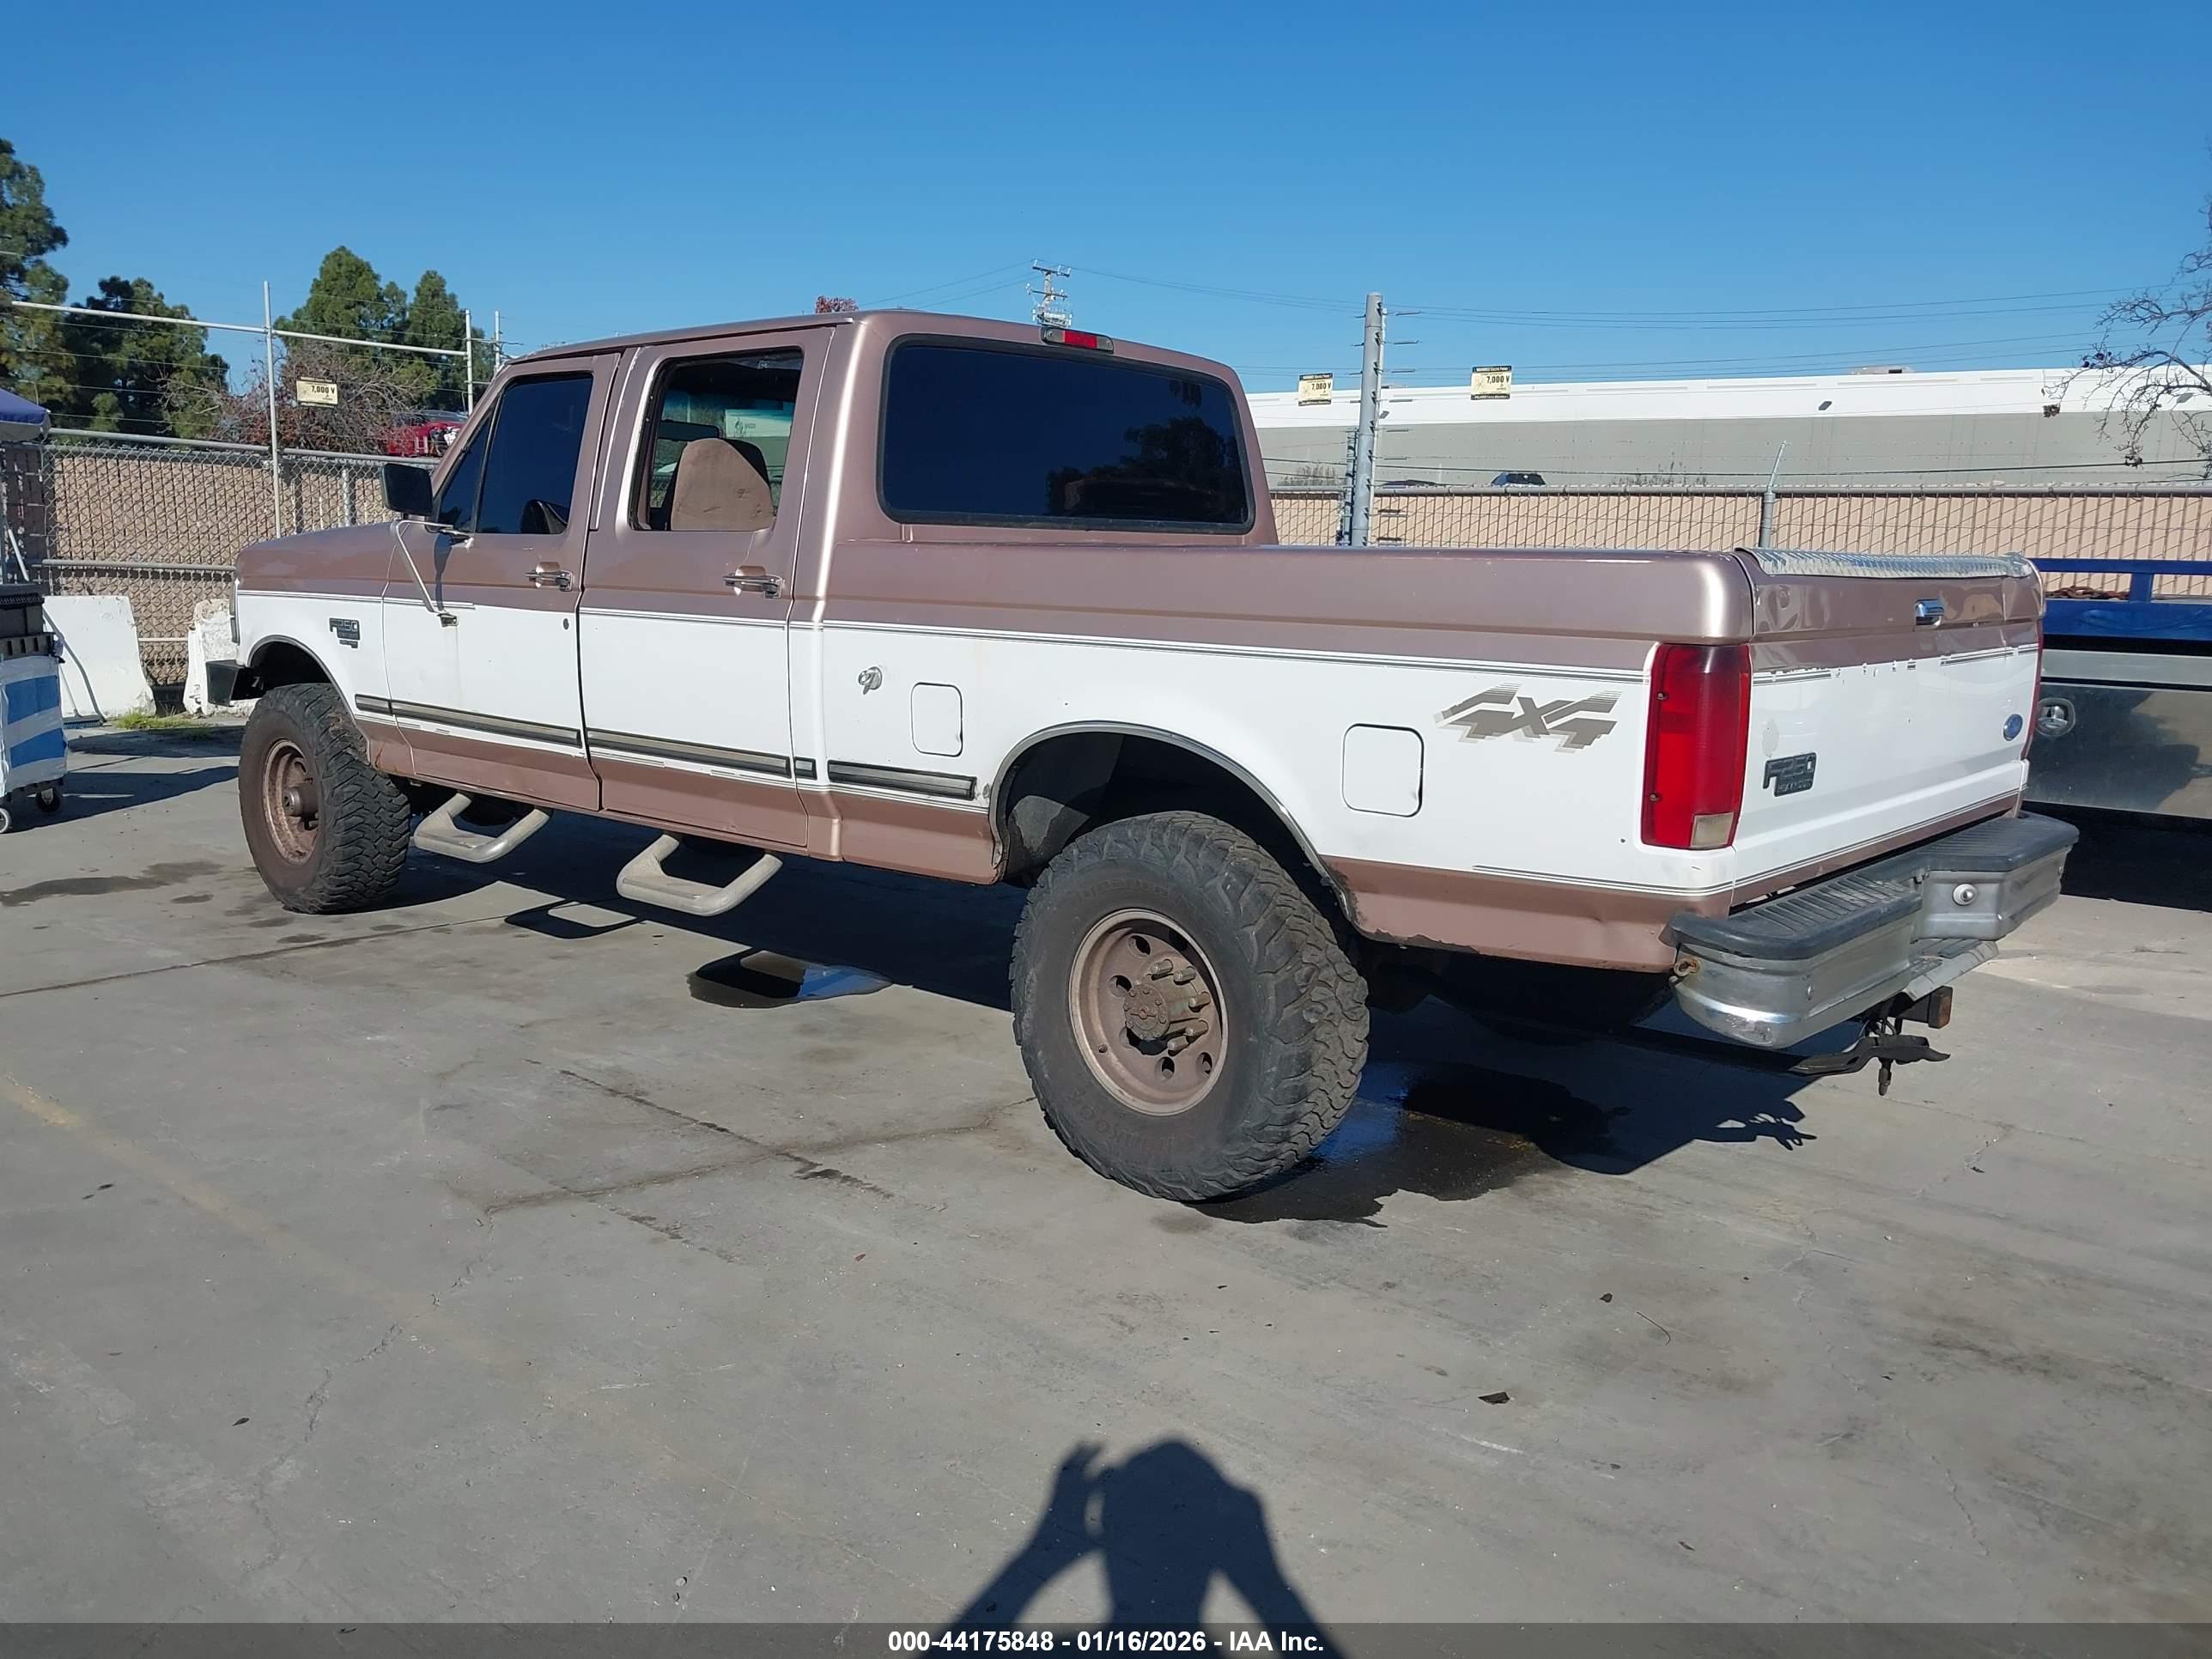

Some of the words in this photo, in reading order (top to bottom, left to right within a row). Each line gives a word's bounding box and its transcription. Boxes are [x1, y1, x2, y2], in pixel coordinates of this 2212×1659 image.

[1486, 375, 1504, 384] 7,000
[1506, 374, 1510, 383] V
[311, 385, 329, 393] 7,000
[1311, 382, 1327, 391] 7,000
